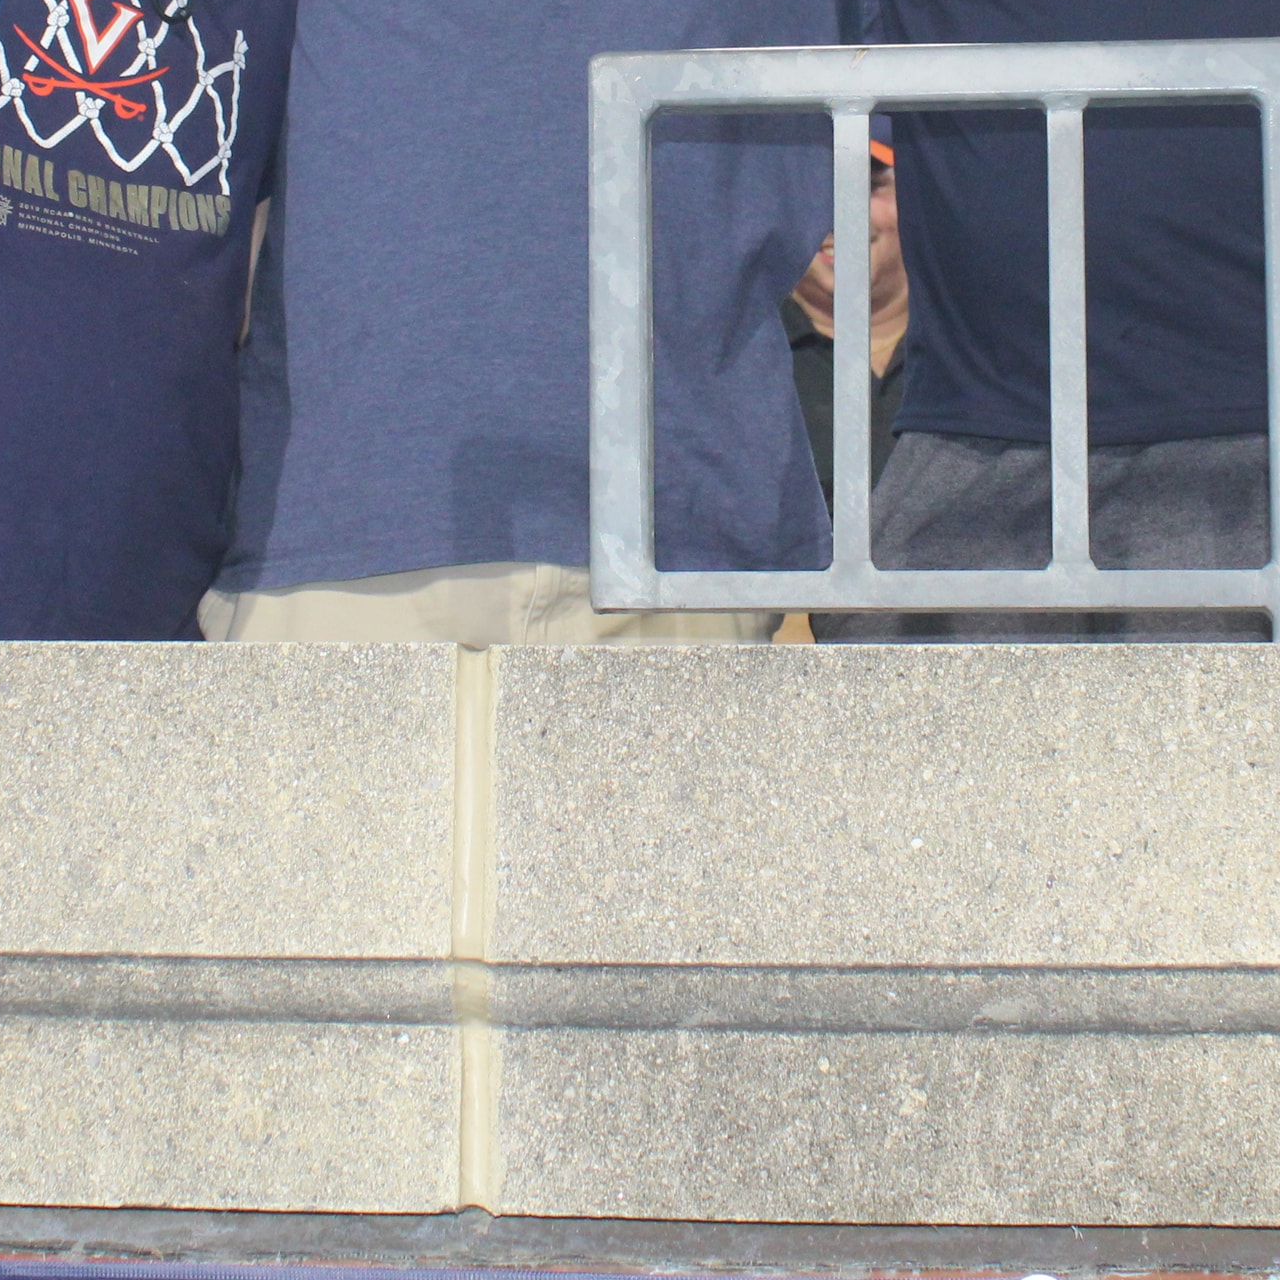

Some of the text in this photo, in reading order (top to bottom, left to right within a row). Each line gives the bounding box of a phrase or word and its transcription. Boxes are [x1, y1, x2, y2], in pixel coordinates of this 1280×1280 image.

[68, 169, 231, 238] CHAMPIONS
[18, 212, 121, 243] NATIONAL CHAMPIONS
[88, 237, 139, 257] MINNESOTA
